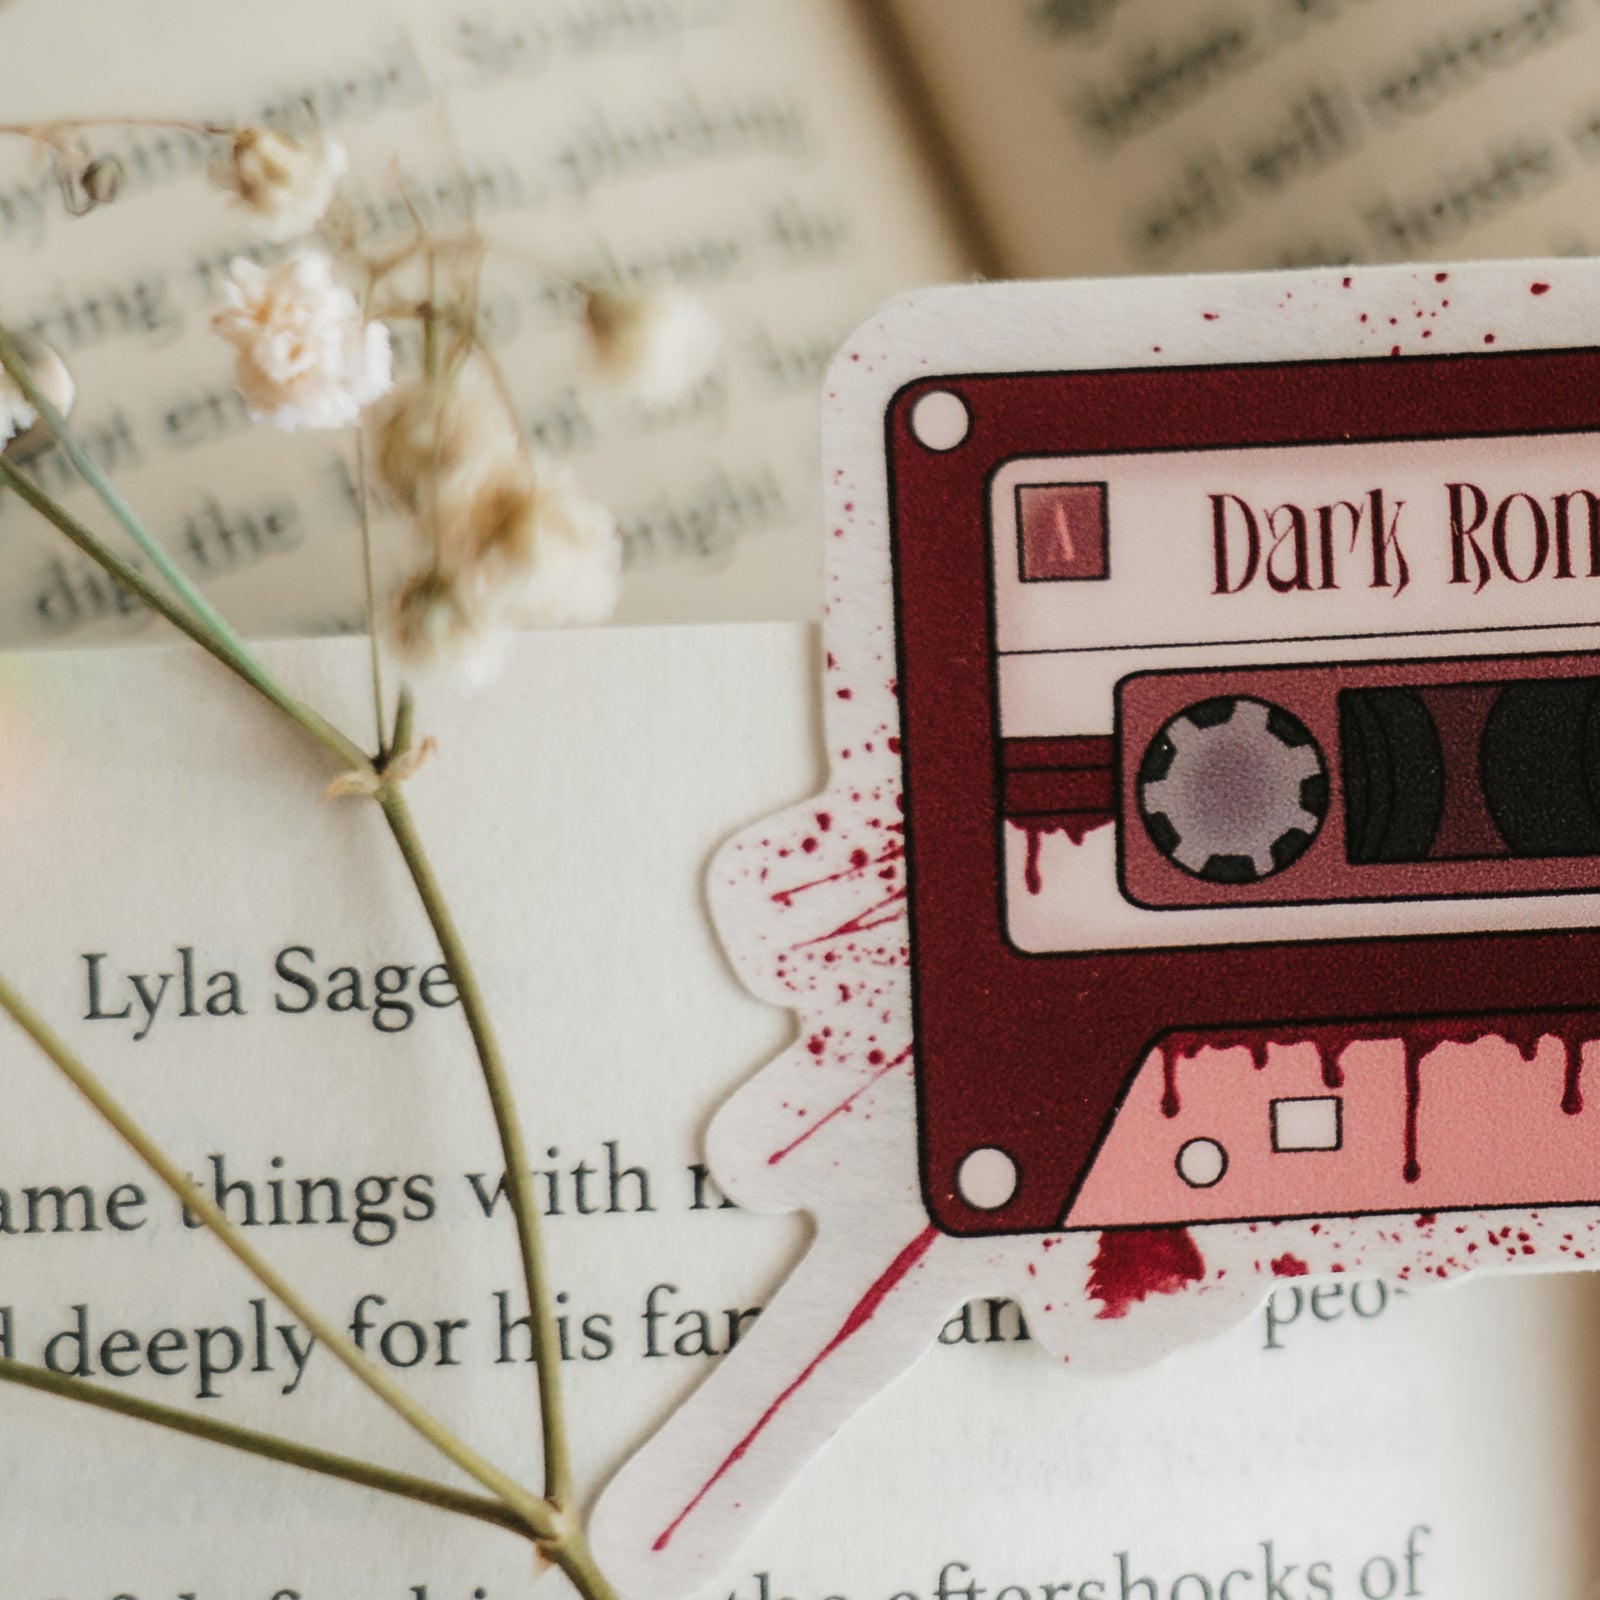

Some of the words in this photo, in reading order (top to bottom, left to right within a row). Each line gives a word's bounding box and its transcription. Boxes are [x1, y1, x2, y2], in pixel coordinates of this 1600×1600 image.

[1207, 488, 1410, 598] Dark
[81, 947, 247, 1042] Lyla
[274, 945, 462, 1033] Sage
[44, 1297, 318, 1400] deeply
